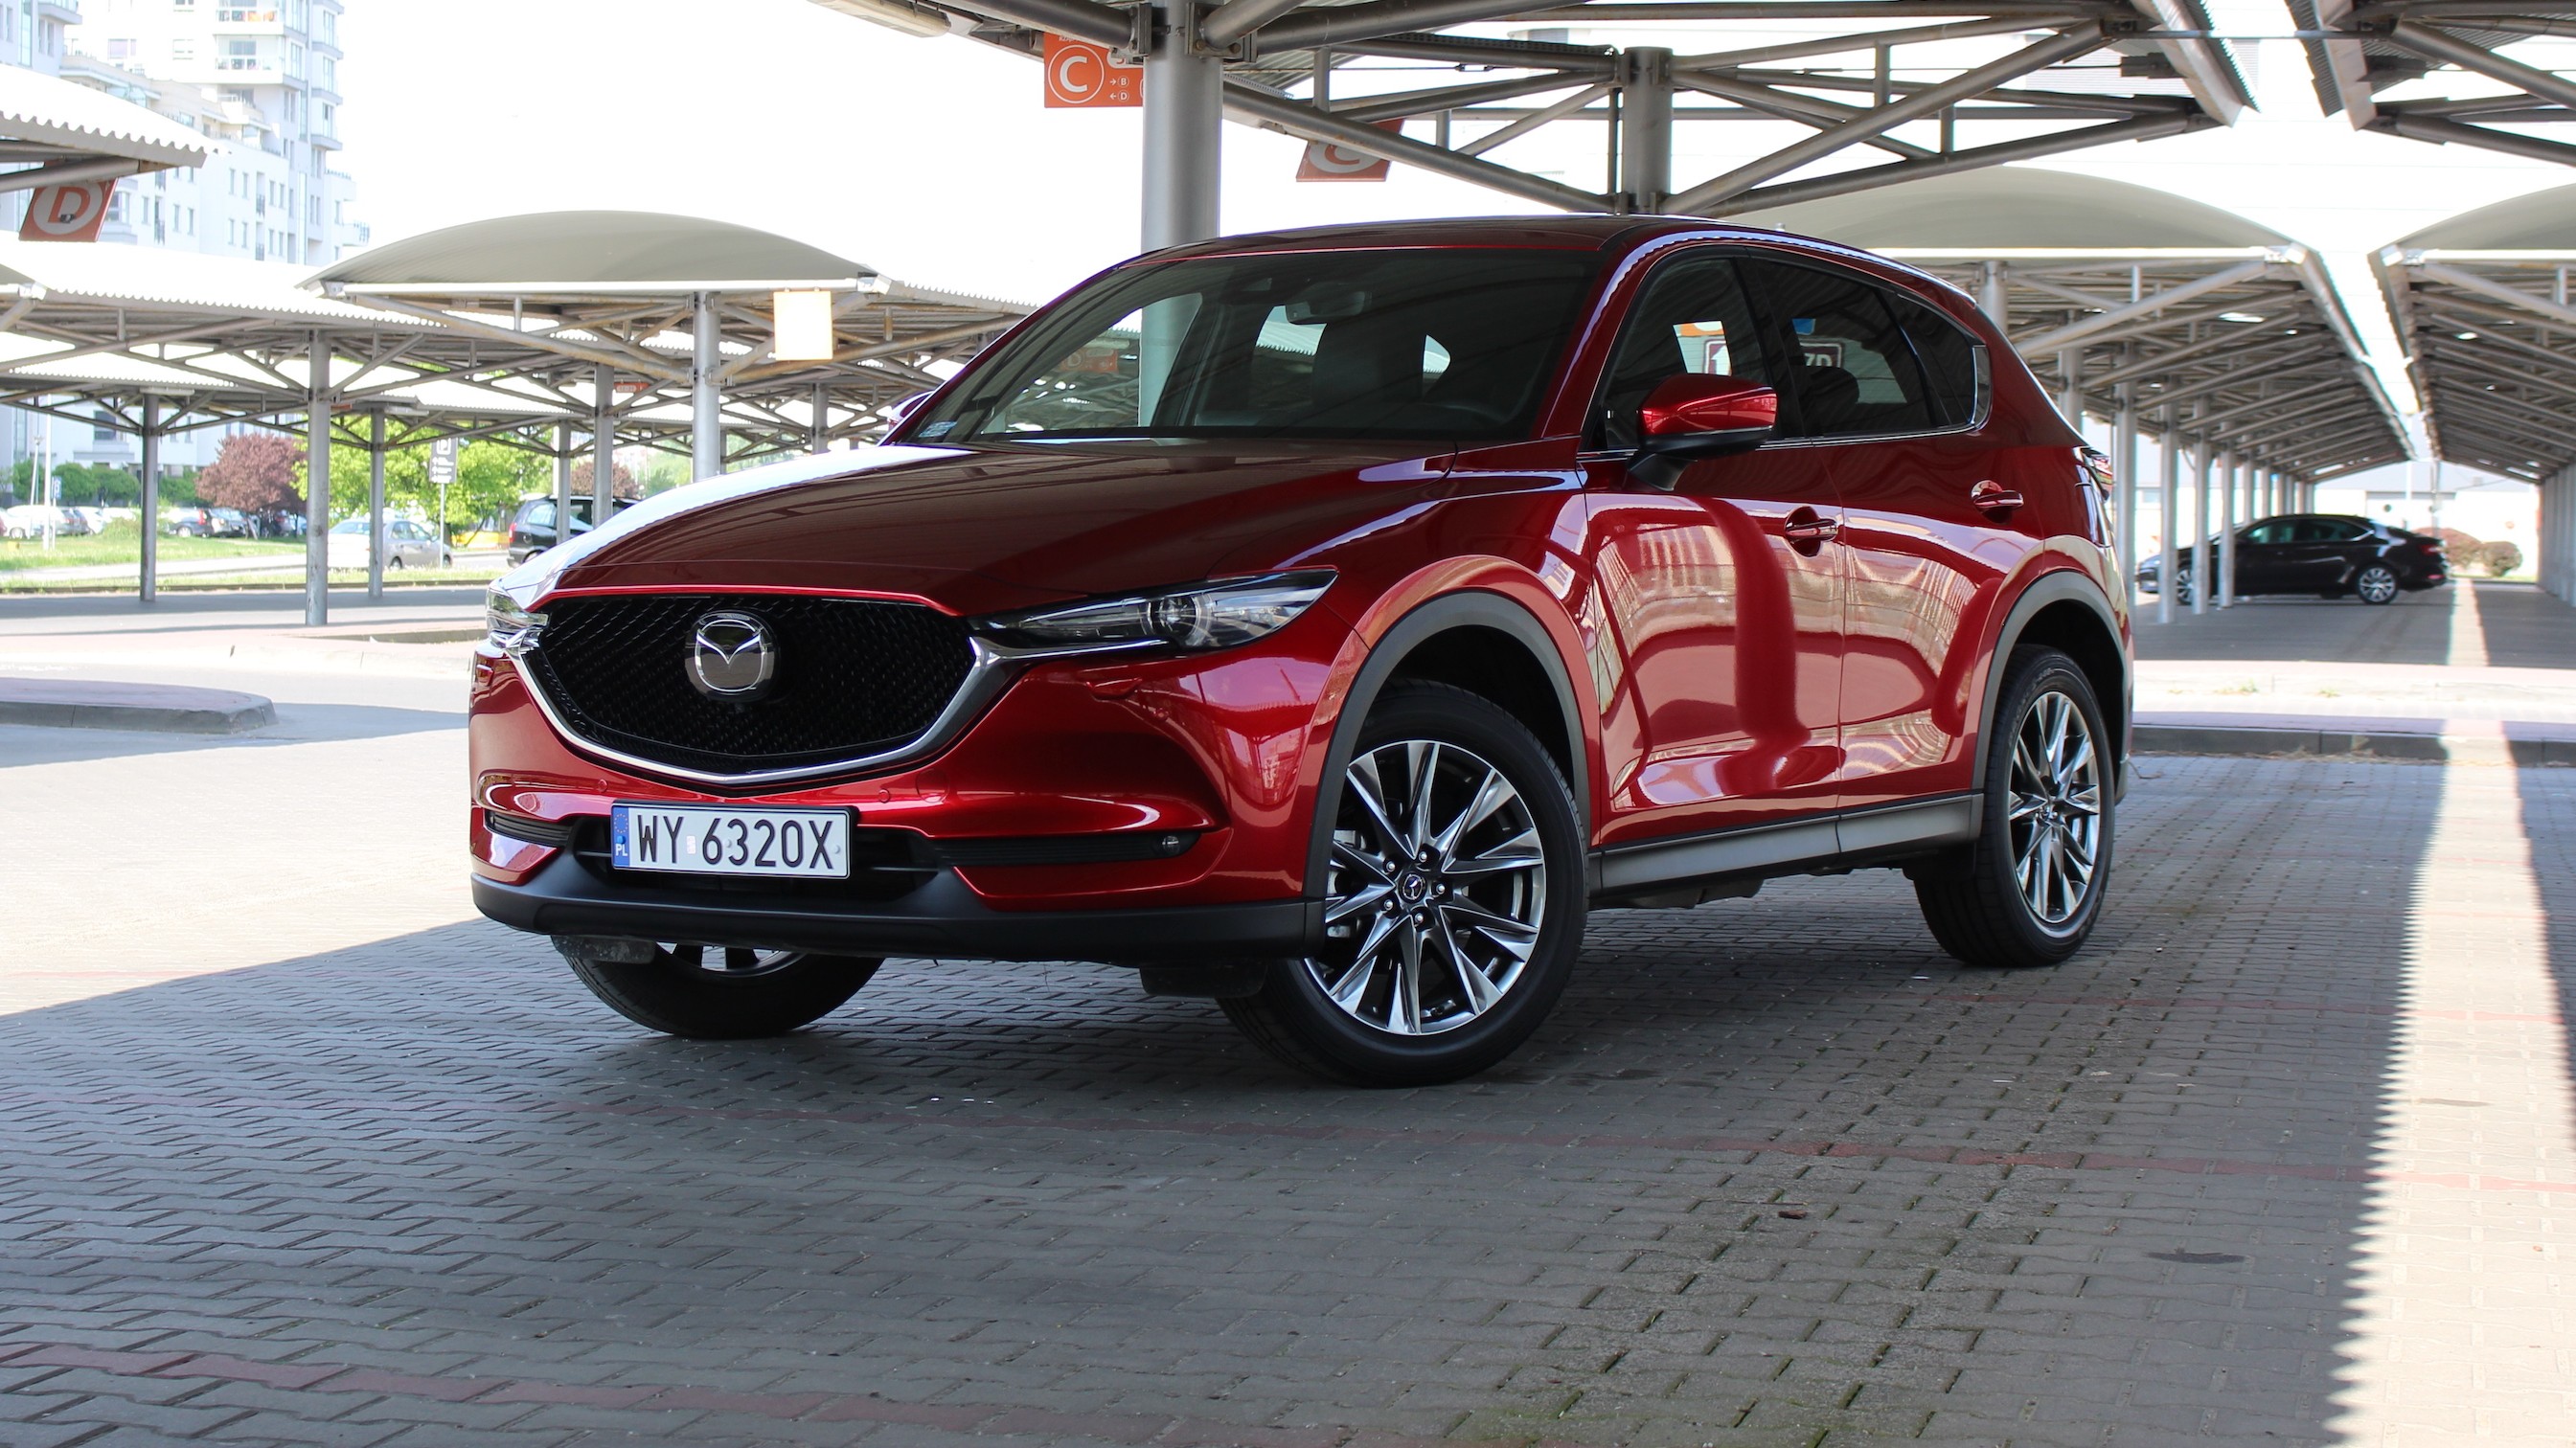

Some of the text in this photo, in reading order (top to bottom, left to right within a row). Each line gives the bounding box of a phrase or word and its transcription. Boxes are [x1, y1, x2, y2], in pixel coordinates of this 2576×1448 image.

[1060, 56, 1088, 93] C
[1120, 78, 1128, 86] B
[1120, 92, 1128, 101] D
[47, 186, 91, 223] D
[615, 843, 628, 857] PL
[637, 814, 833, 870] WY 6320X
